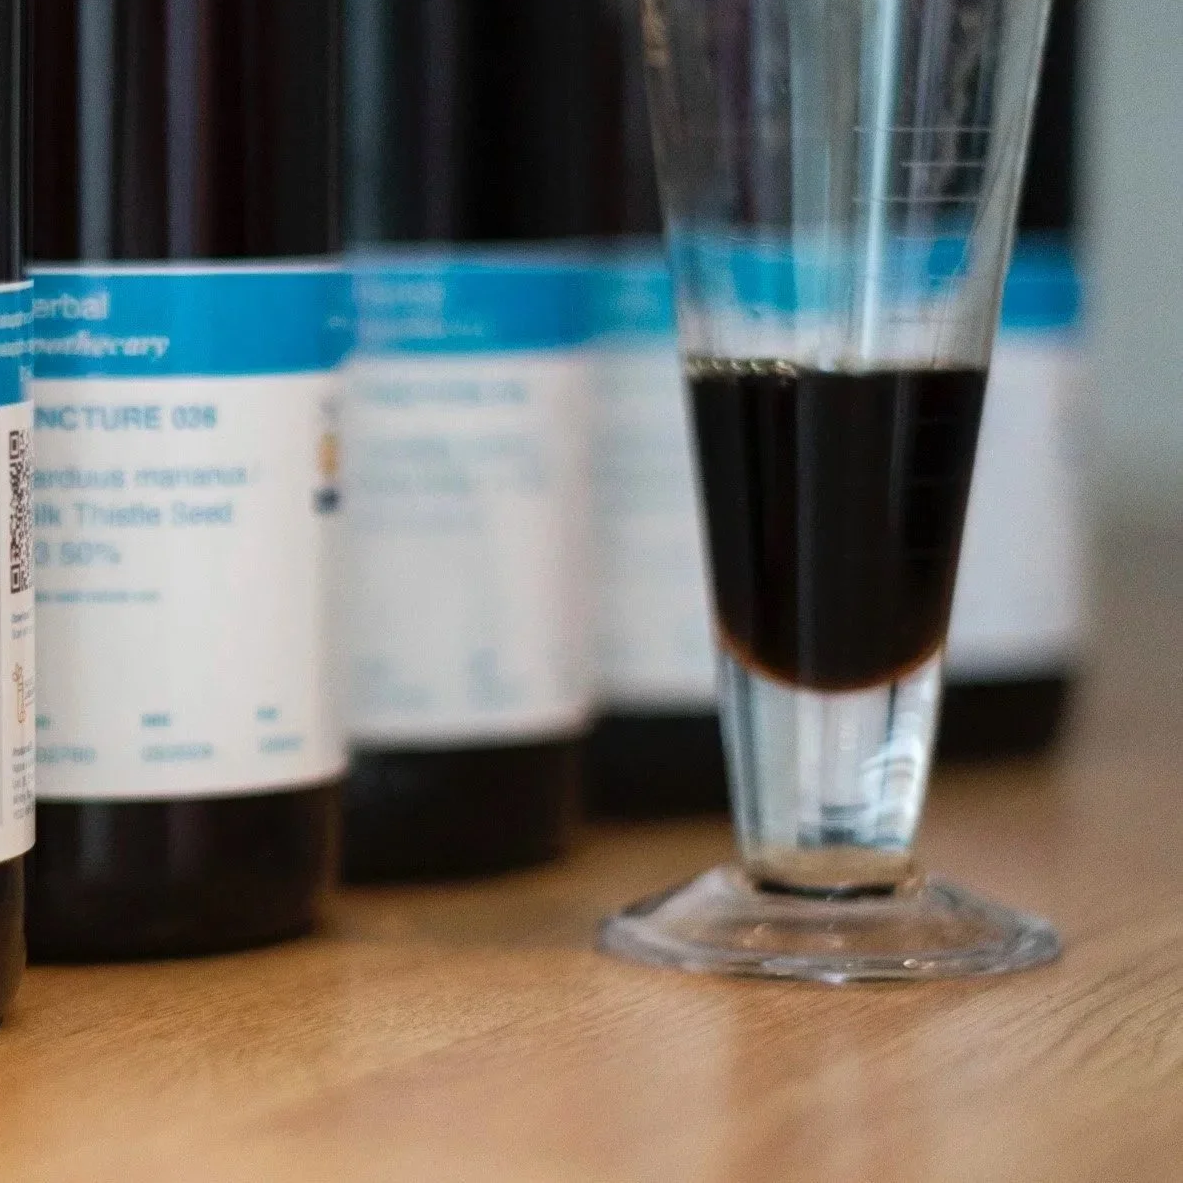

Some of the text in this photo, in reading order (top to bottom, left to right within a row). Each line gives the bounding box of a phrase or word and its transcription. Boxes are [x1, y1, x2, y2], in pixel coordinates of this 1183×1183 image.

[32, 291, 110, 320] erbal
[34, 502, 61, 526] ilk
[172, 502, 234, 526] Seed
